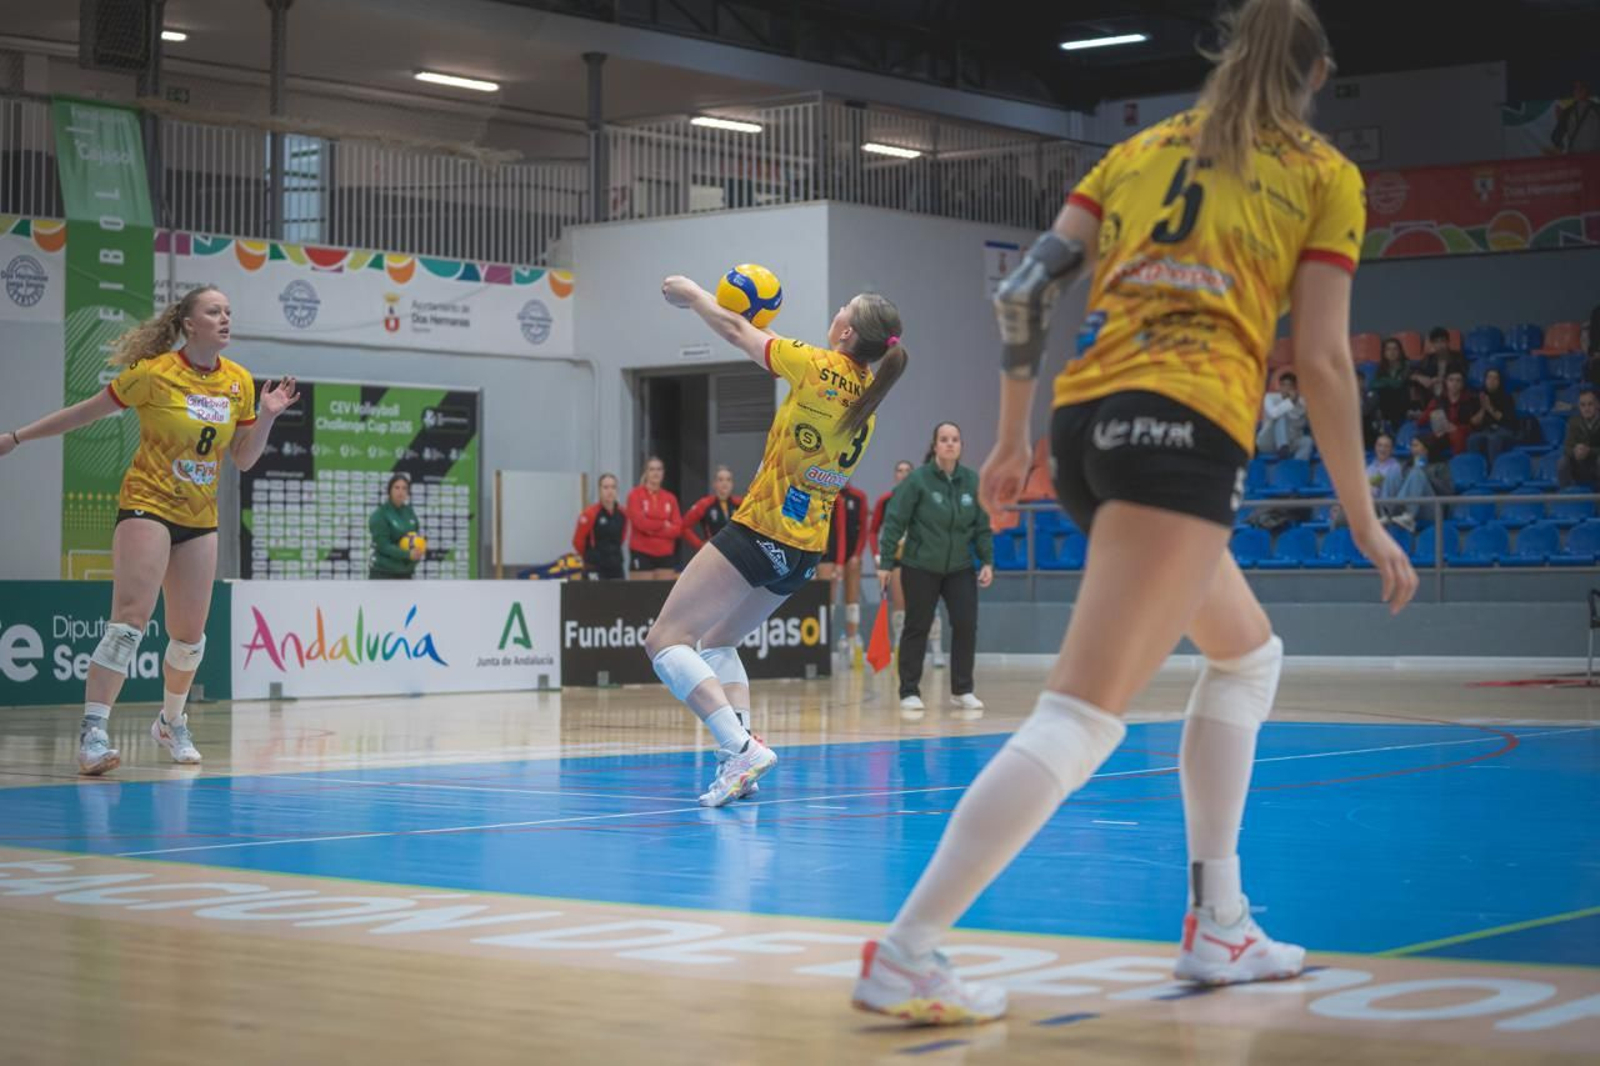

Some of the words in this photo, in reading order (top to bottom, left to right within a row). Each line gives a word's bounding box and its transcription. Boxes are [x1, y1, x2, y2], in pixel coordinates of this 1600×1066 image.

[1151, 157, 1213, 243] 5
[819, 368, 861, 396] STRIK
[330, 400, 351, 414] CEV
[353, 401, 400, 418] Volleyball
[196, 426, 217, 455] 8
[368, 419, 388, 436] Cup
[838, 421, 869, 468] 3
[53, 615, 159, 642] Diputn
[241, 604, 449, 673] Andalucía
[565, 618, 653, 648] Fundac
[737, 605, 827, 659] ajasol
[0, 622, 44, 682] e
[53, 644, 159, 681] Sela
[476, 656, 500, 668] Junta
[501, 655, 512, 666] de
